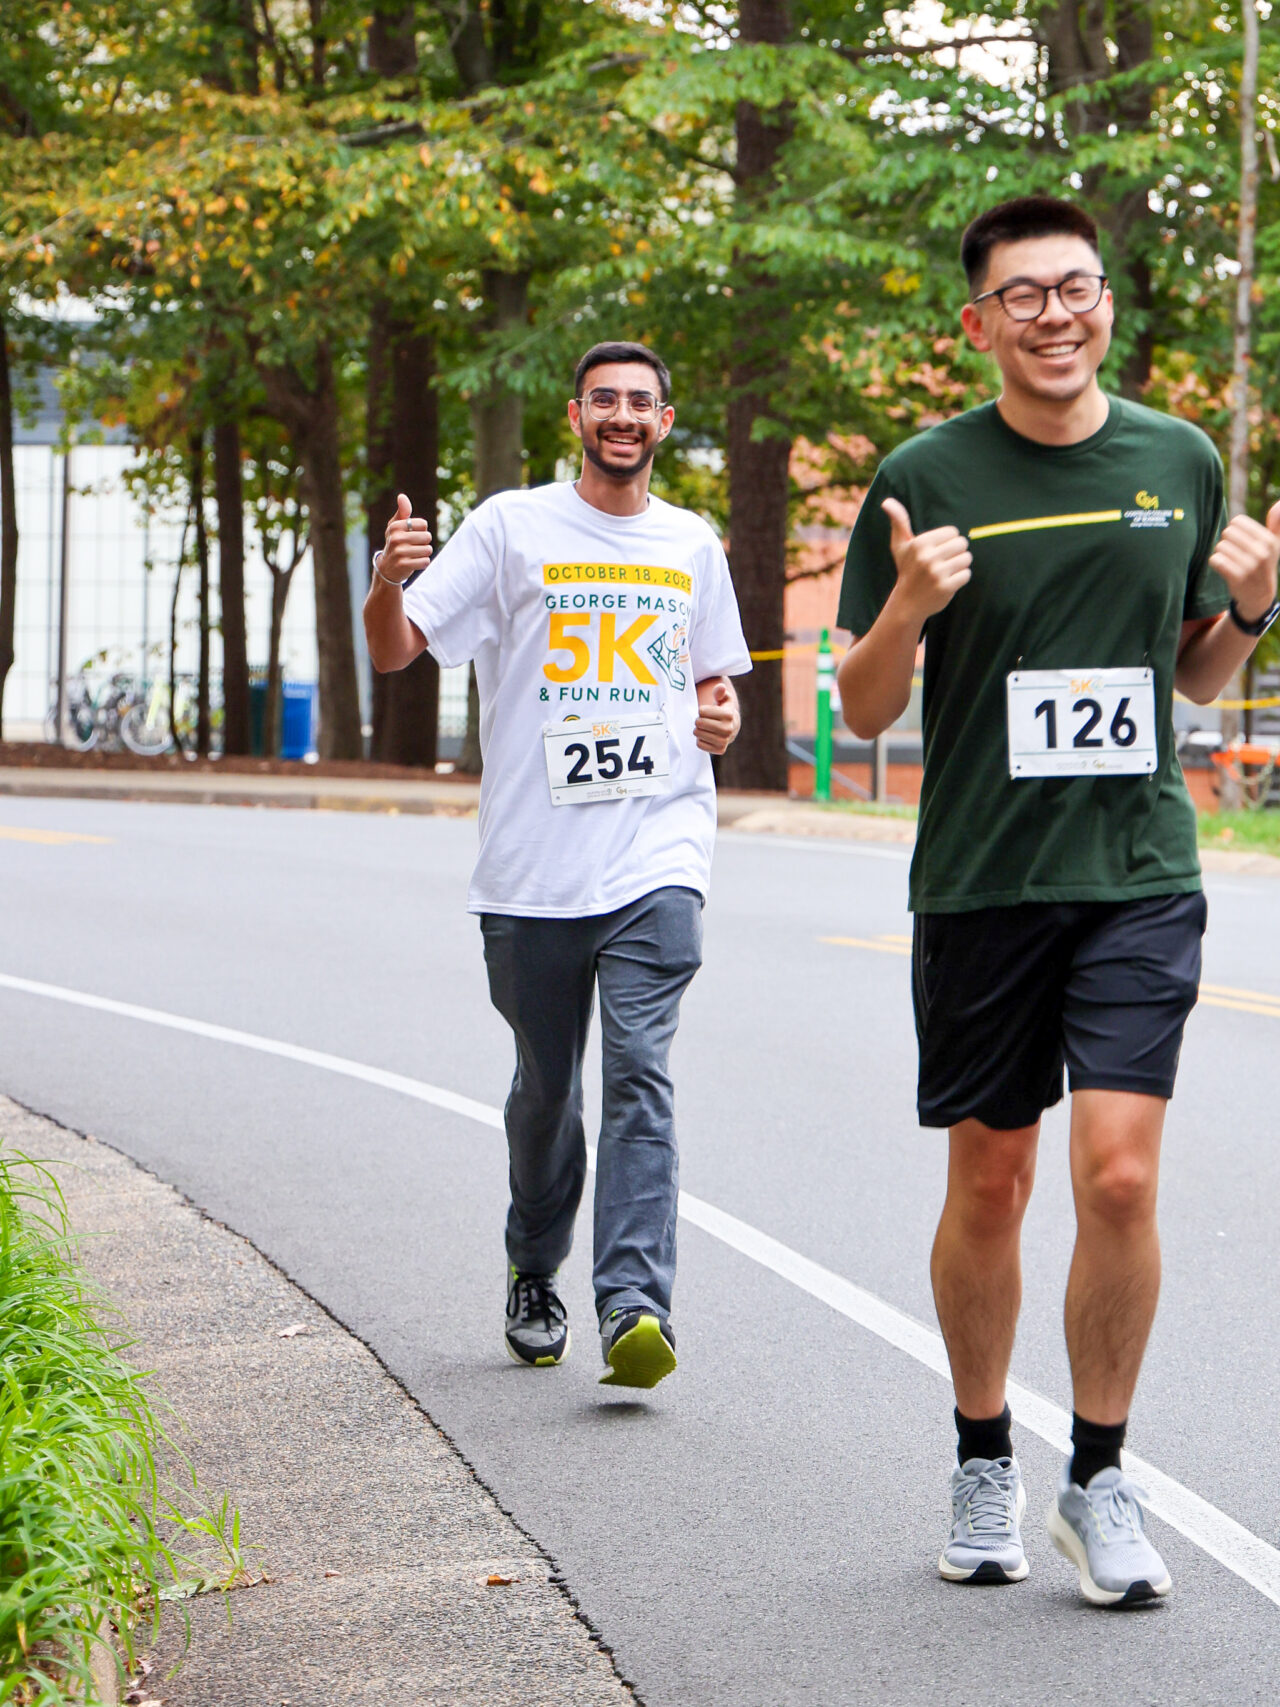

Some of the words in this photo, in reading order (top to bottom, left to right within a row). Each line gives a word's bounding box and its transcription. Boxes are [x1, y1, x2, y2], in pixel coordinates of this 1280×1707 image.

[548, 566, 628, 581] OCTOBER
[635, 568, 657, 584] 18,
[545, 594, 627, 609] GEORGE
[542, 612, 660, 686] 5K
[539, 687, 550, 702] &
[559, 687, 600, 702] FUN
[609, 688, 650, 703] RUN
[1070, 678, 1093, 695] 5K
[592, 723, 612, 737] 5K
[1034, 697, 1137, 749] 126
[564, 735, 655, 785] 254
